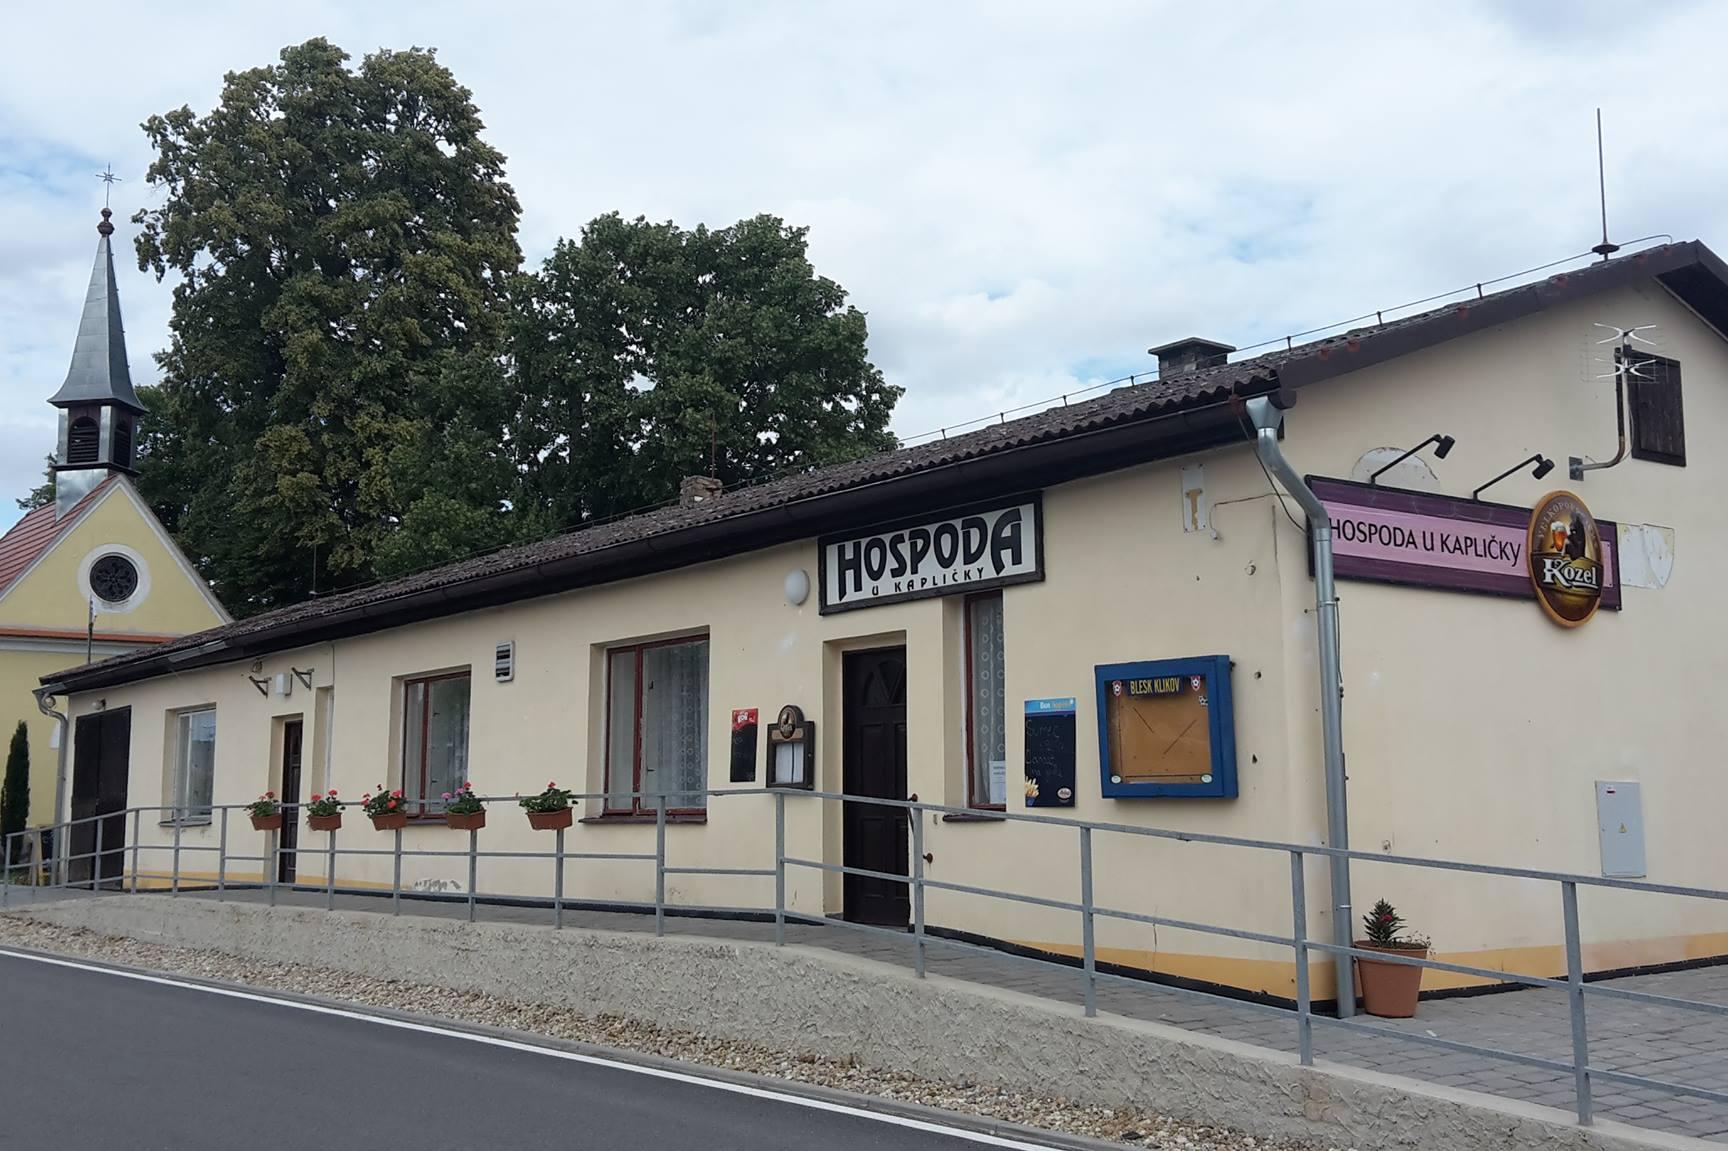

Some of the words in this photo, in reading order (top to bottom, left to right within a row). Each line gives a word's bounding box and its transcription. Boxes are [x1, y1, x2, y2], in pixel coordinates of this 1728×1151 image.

[838, 507, 1023, 602] HOSPODA
[1329, 518, 1418, 550] HOSPODA
[1422, 530, 1434, 551] U
[1440, 533, 1521, 567] KAPLIČKY
[872, 585, 879, 596] U
[894, 567, 984, 593] KAPLIČKY
[1543, 558, 1598, 588] Kozel
[1130, 680, 1153, 695] BLESK
[1154, 678, 1180, 693] KLIKOV
